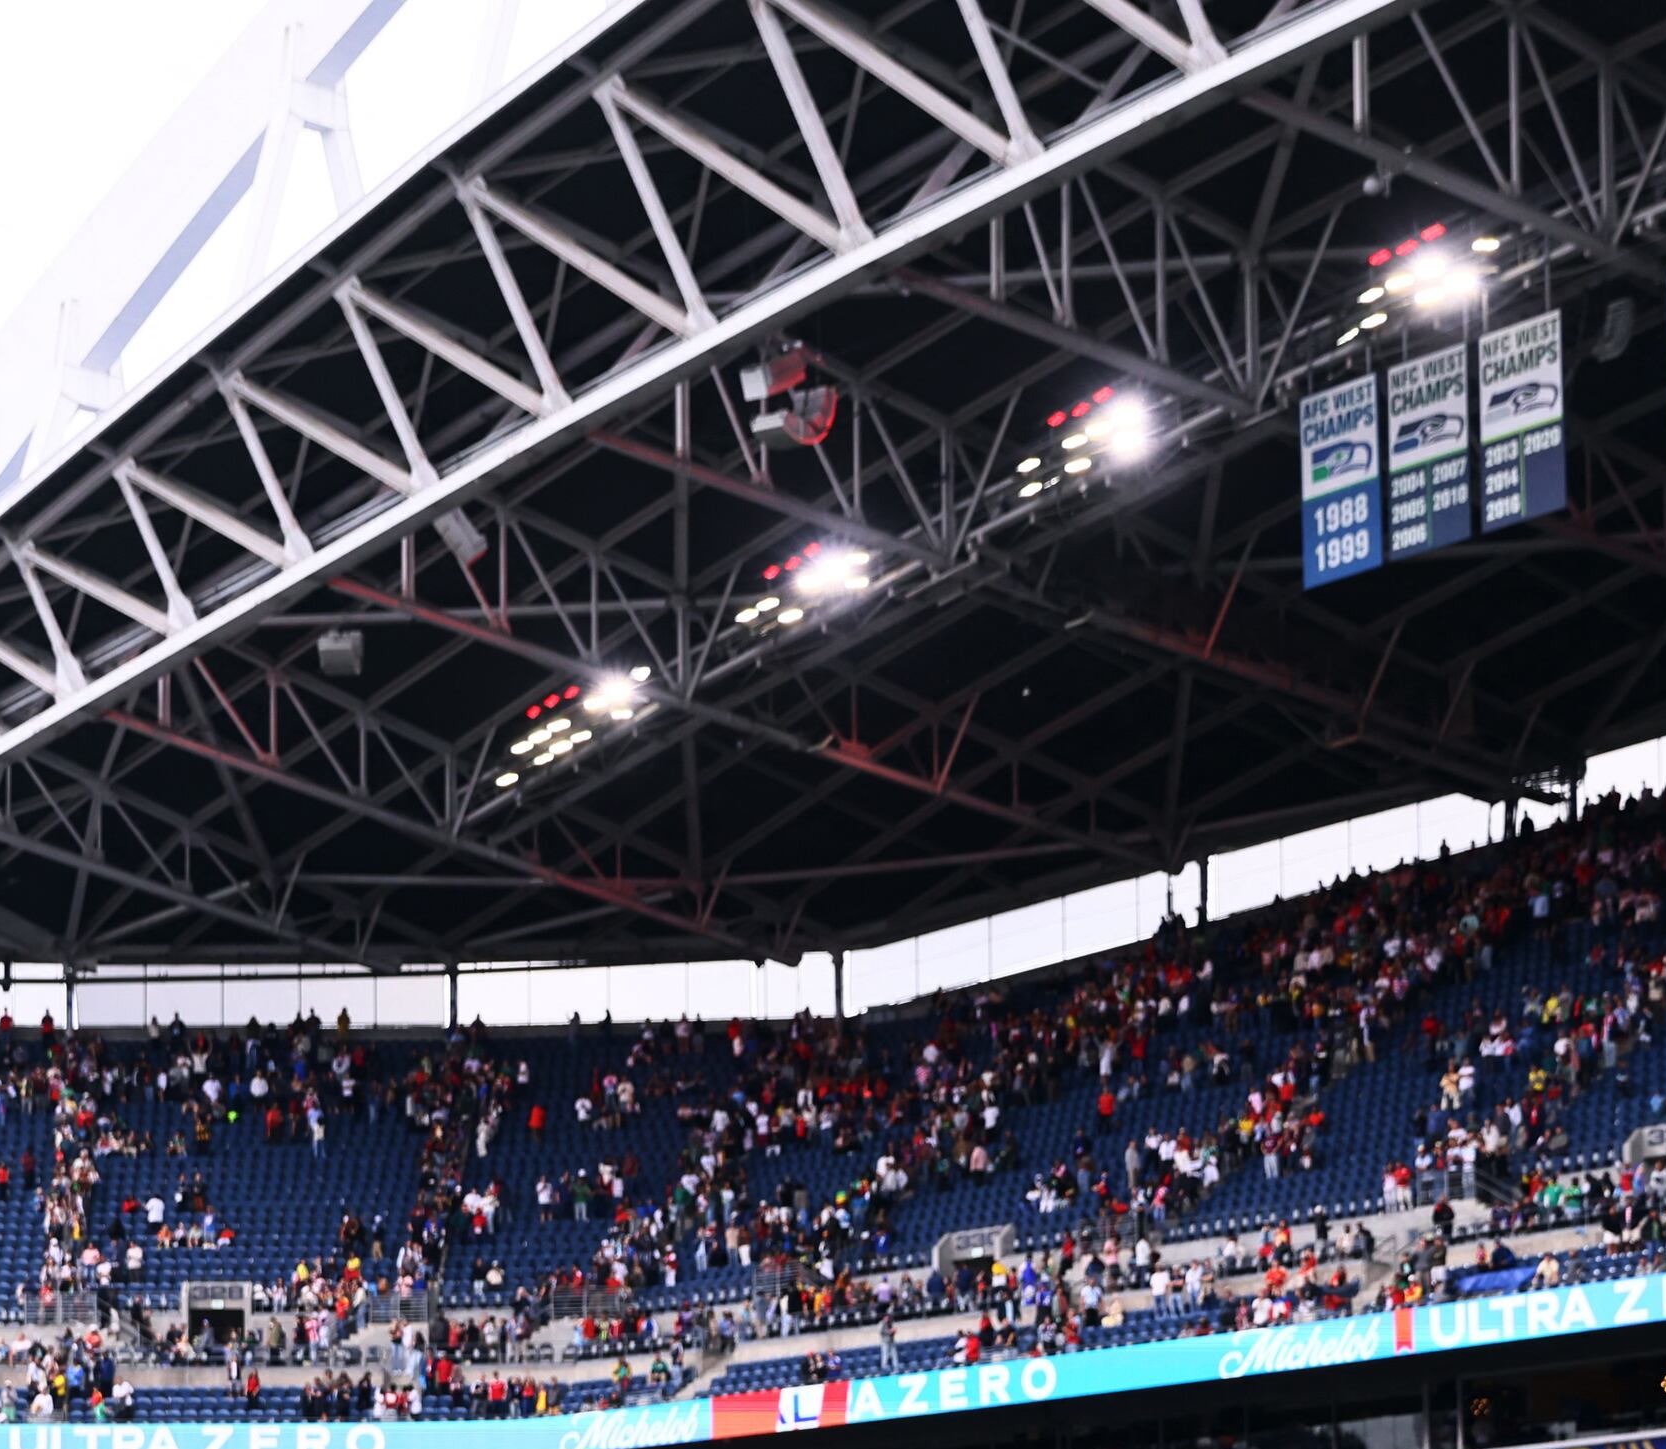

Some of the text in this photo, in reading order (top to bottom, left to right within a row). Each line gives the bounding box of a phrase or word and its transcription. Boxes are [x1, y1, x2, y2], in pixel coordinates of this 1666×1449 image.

[1482, 318, 1558, 360] NFC WEST
[1392, 351, 1464, 391] NFC WEST
[1482, 341, 1558, 385] CHAMPS
[1333, 382, 1373, 408] WEST
[1391, 374, 1464, 417] CHAMPS
[1303, 404, 1374, 446] CHAMPS
[1314, 492, 1368, 536] 1988
[1314, 529, 1369, 572] 1999
[1219, 1314, 1378, 1379] Michelob
[1433, 1291, 1599, 1346] ULTRA
[898, 1358, 1057, 1412] ZERO
